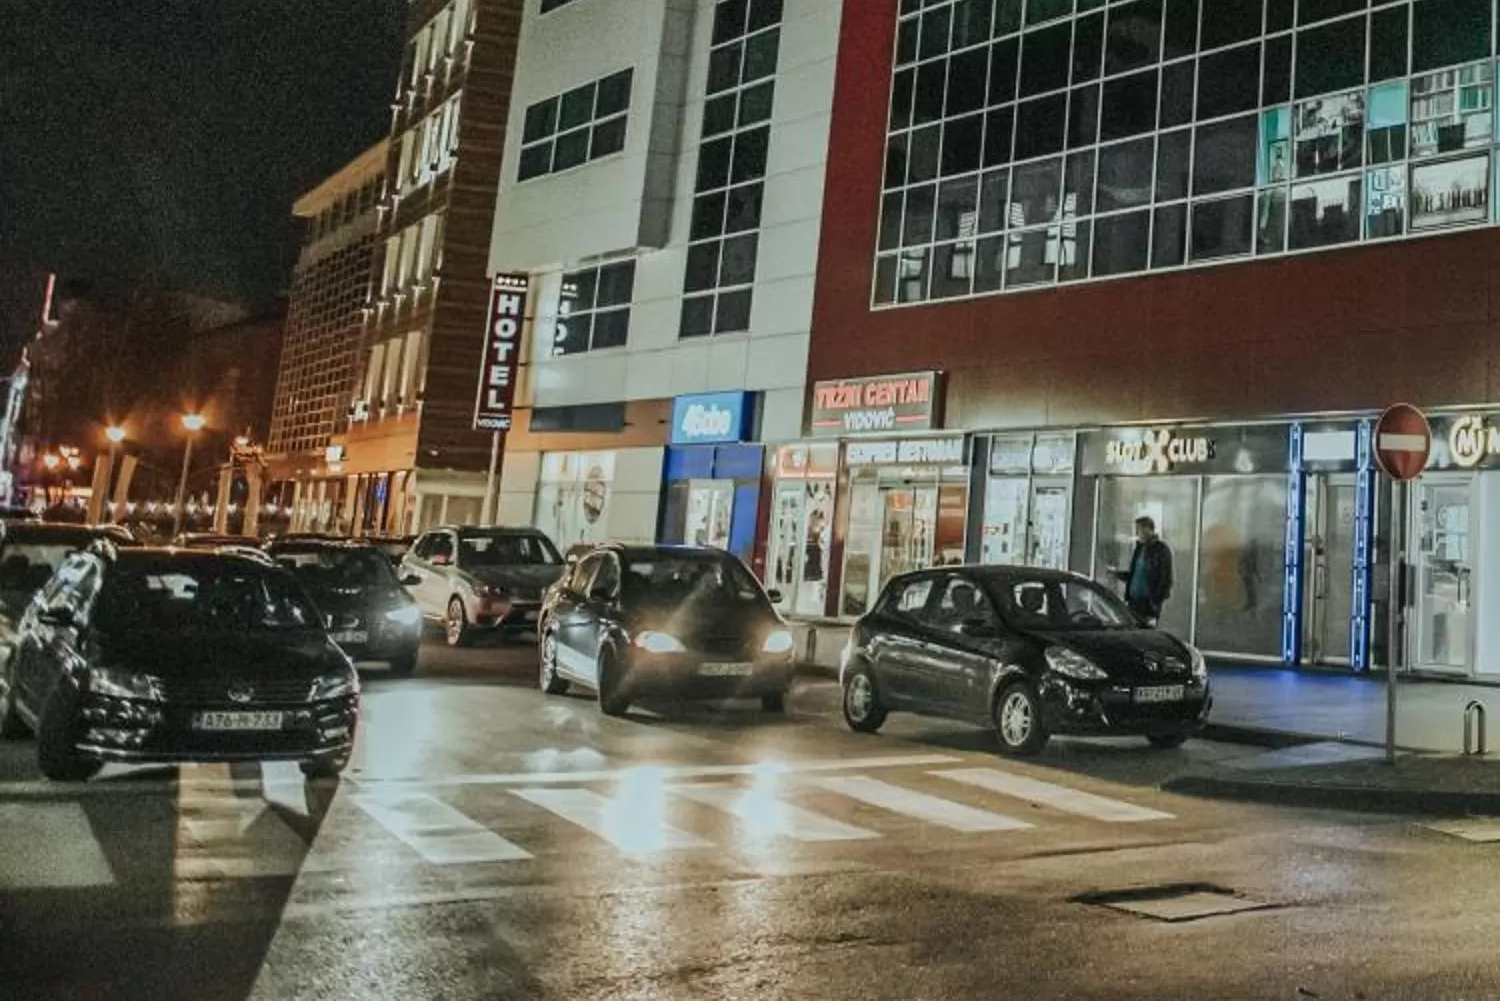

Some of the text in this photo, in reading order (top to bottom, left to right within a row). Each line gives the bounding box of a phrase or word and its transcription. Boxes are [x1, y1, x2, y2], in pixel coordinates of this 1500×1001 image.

[488, 294, 520, 408] HOTEL
[865, 378, 929, 406] CENTAR
[1106, 440, 1143, 464] SLOT
[1169, 437, 1208, 462] CLUB
